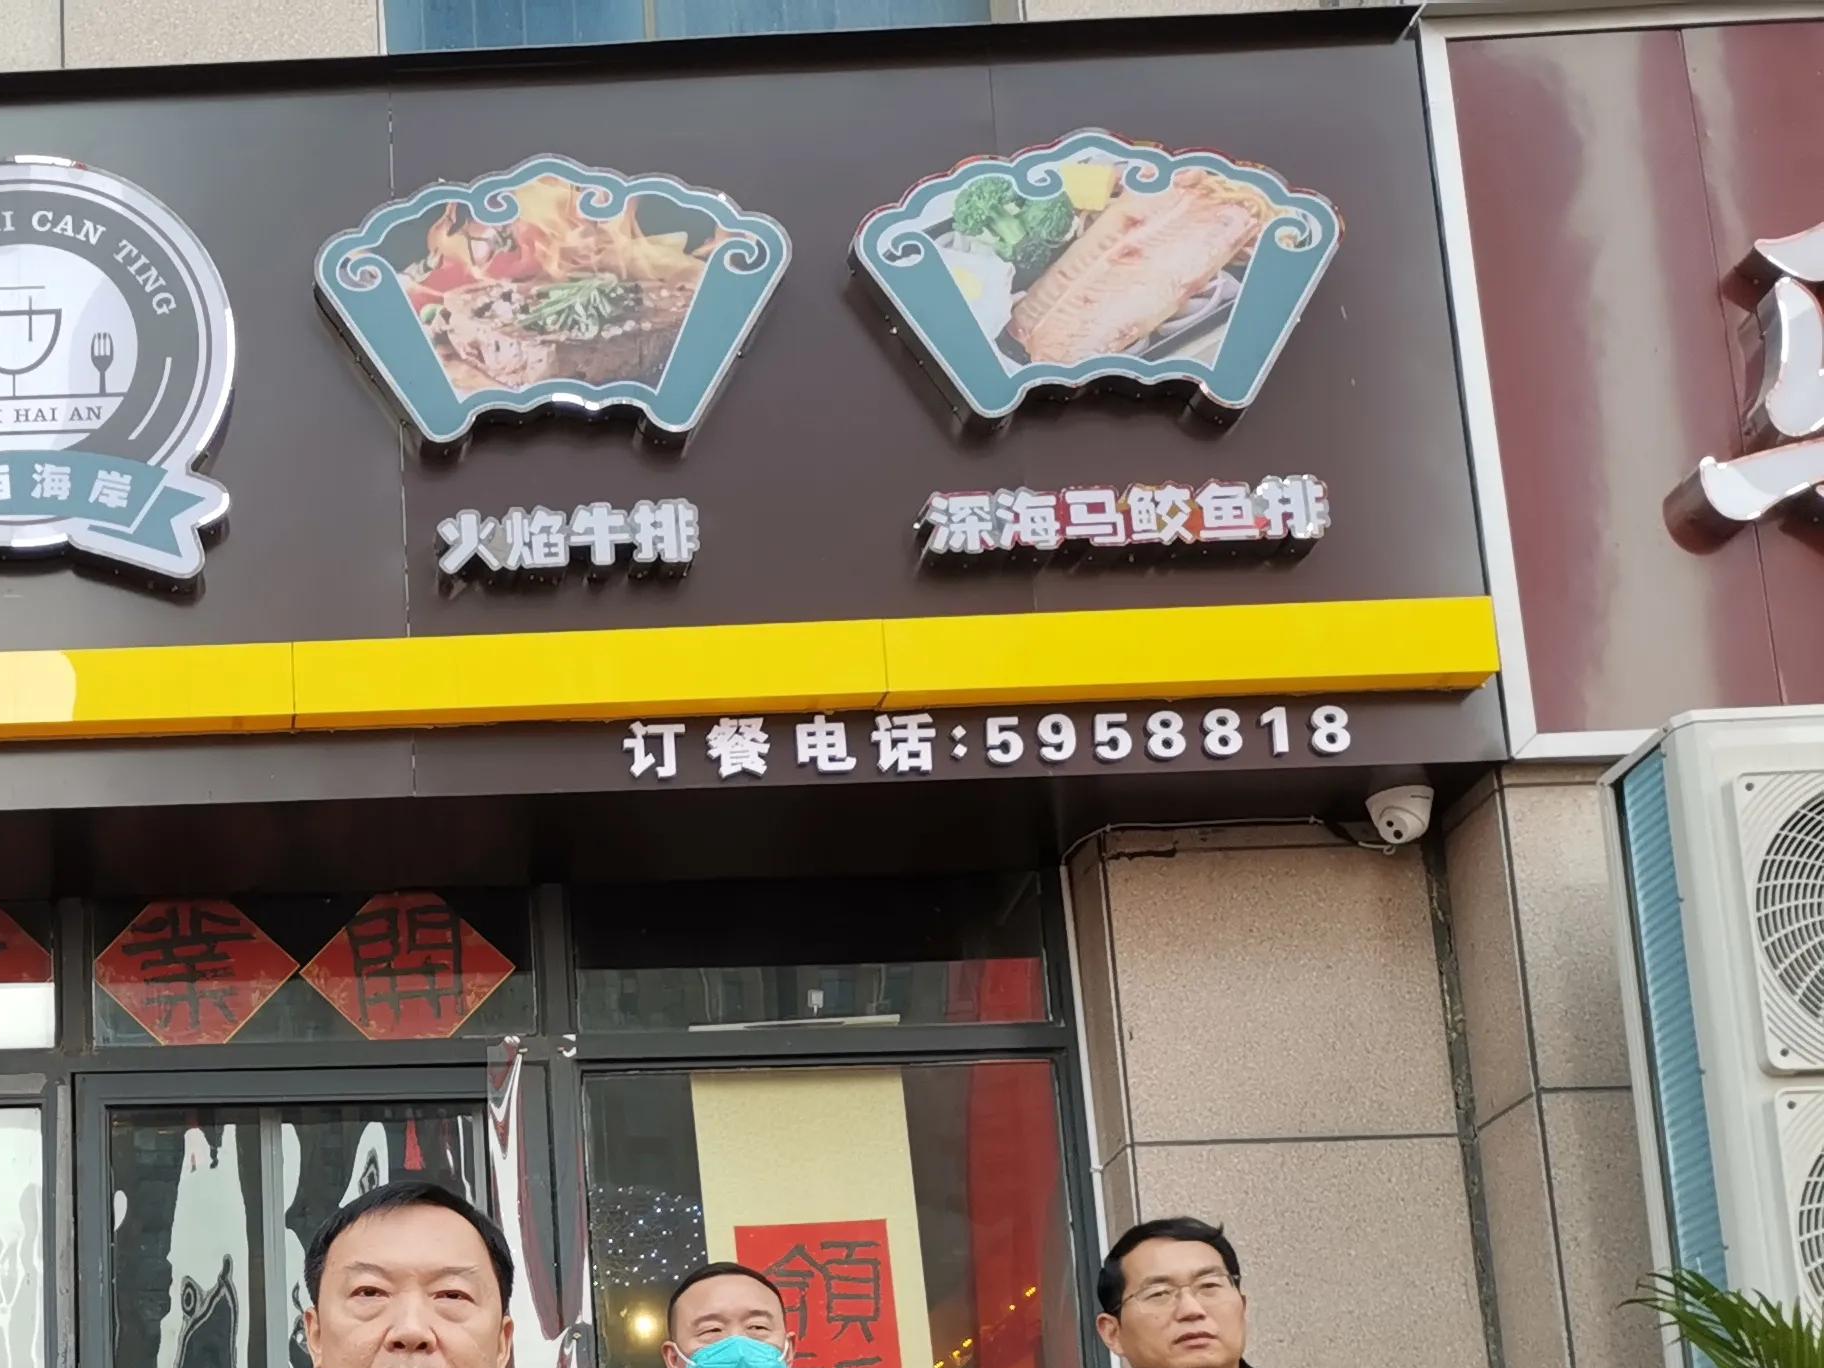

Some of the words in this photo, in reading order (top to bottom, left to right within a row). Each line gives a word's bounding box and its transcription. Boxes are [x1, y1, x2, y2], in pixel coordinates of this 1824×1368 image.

[30, 209, 107, 246] CAN
[112, 238, 177, 316] TING
[13, 407, 59, 424] HAI
[68, 405, 104, 423] AN
[436, 498, 701, 574] 火焰牛排
[929, 474, 1331, 554] 深海马鲛鱼排
